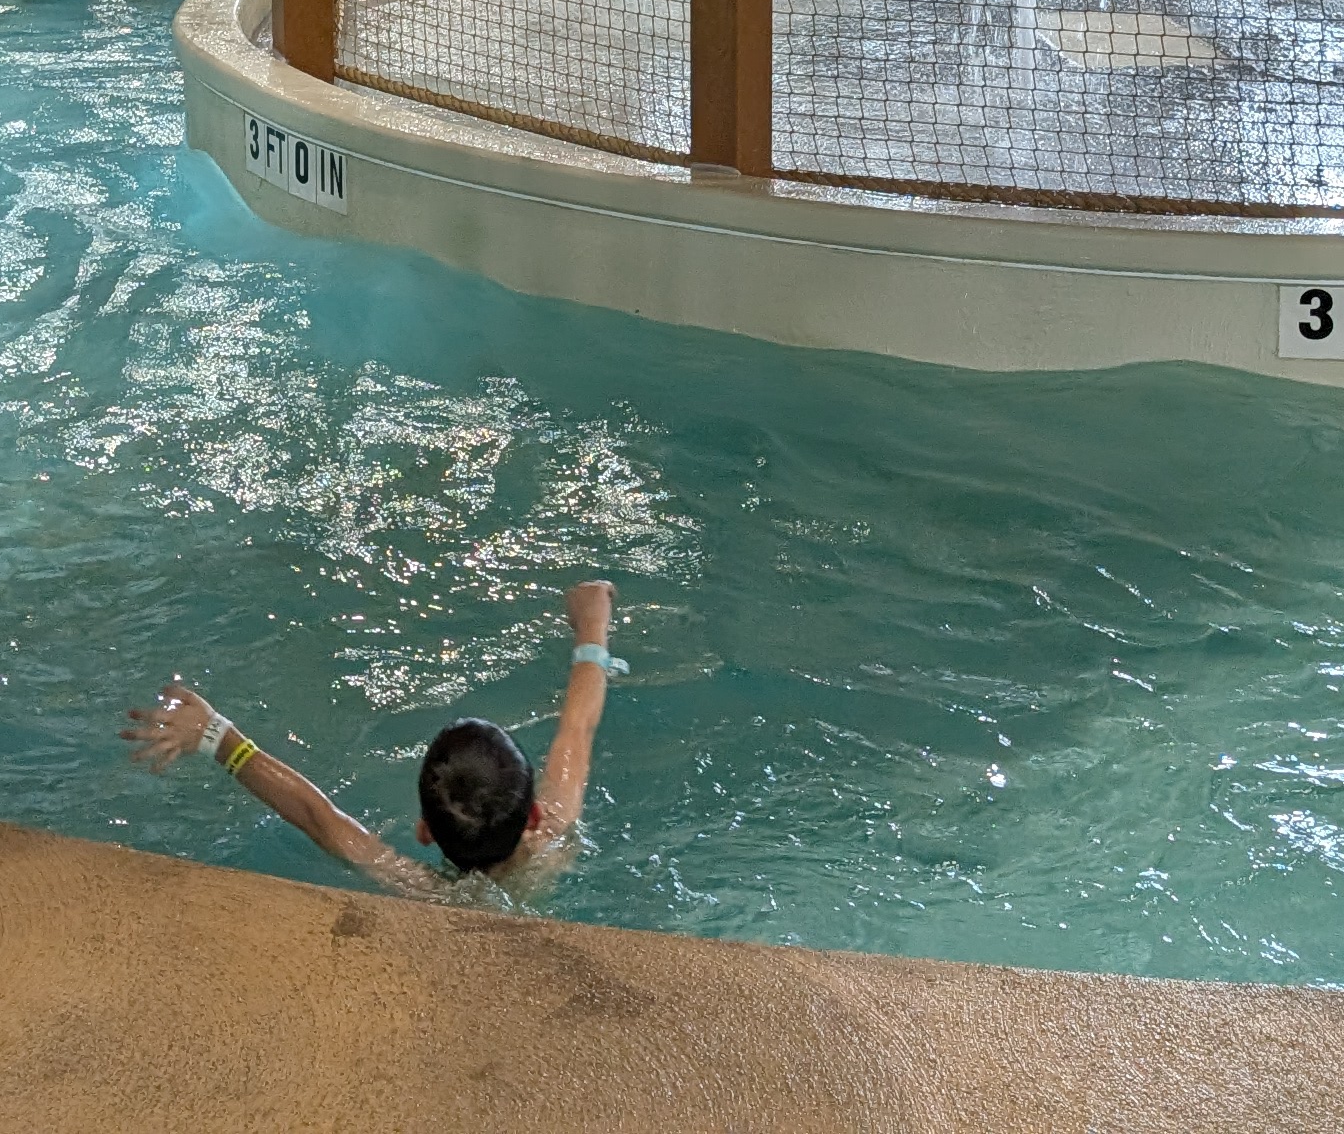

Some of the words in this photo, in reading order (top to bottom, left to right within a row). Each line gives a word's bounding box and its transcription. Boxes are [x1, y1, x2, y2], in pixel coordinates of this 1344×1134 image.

[249, 118, 260, 160] 3
[266, 125, 286, 175] FT
[320, 148, 344, 200] IN
[1298, 288, 1334, 340] 3
